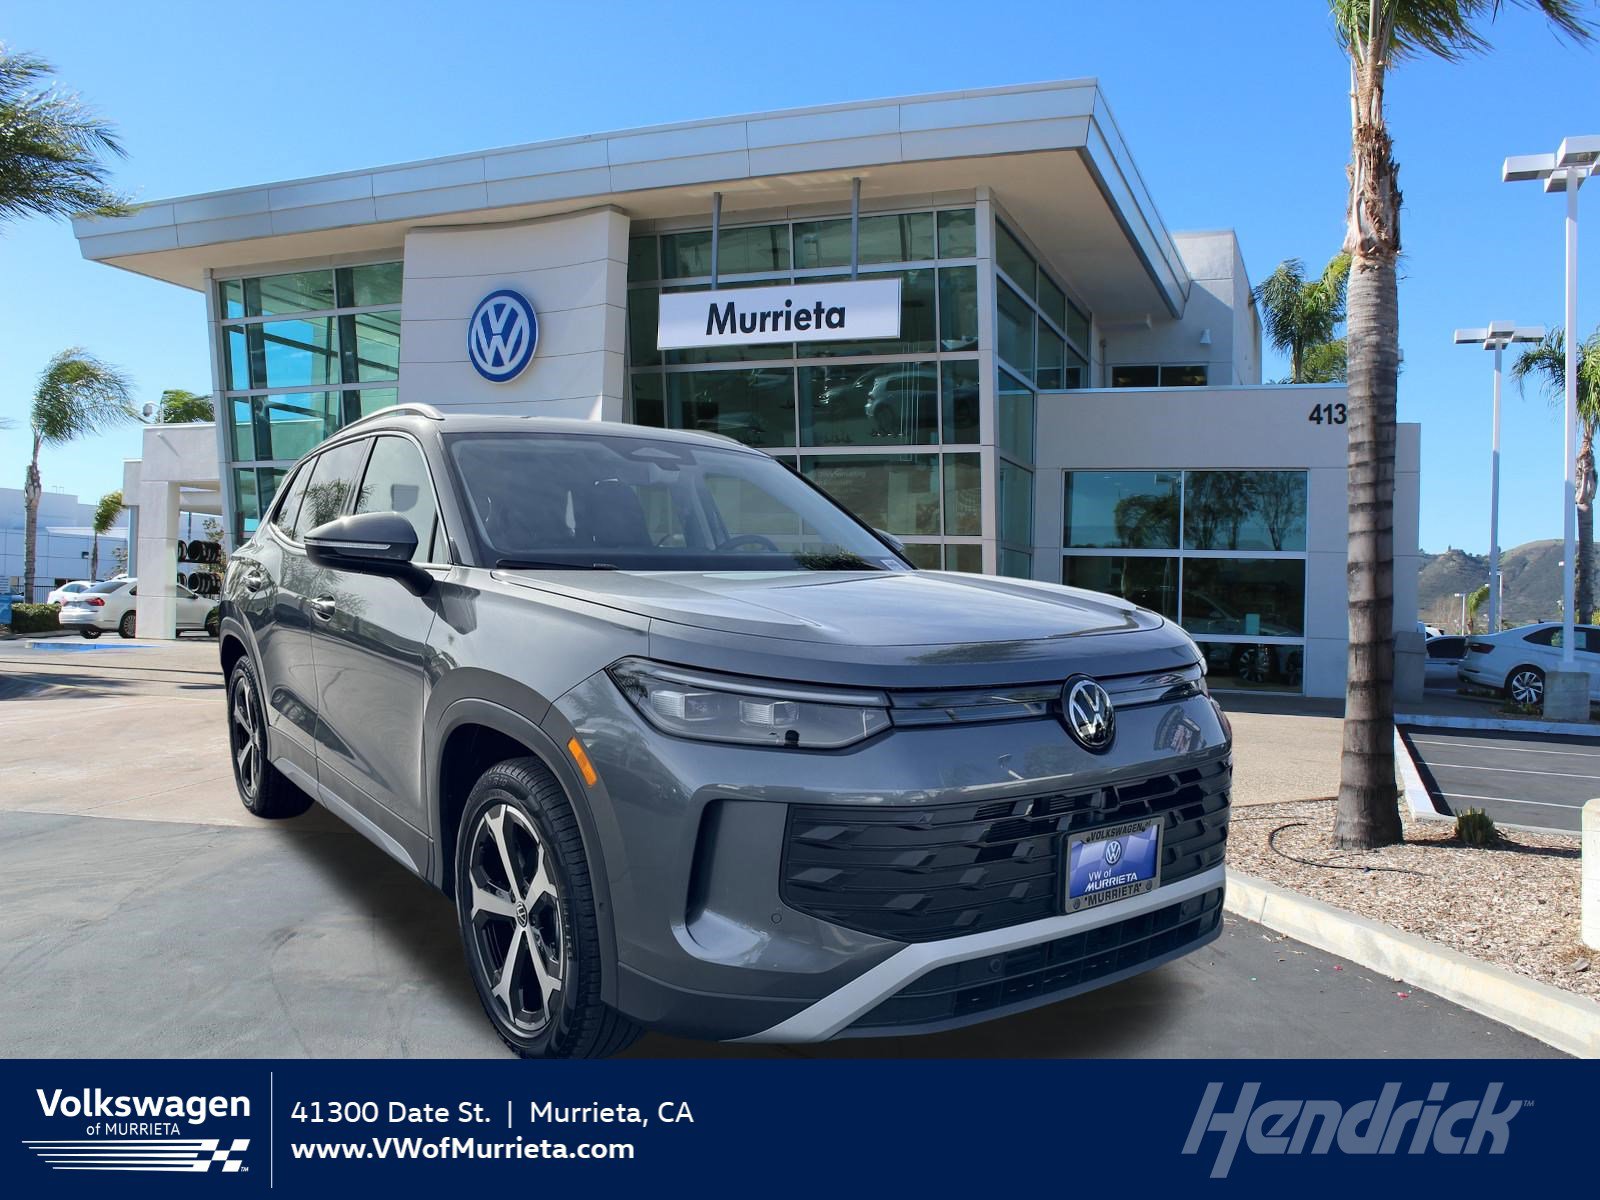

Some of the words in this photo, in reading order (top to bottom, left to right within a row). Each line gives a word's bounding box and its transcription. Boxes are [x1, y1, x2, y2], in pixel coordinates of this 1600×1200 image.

[705, 298, 846, 336] Murrieta
[1308, 403, 1347, 425] 413
[1090, 823, 1143, 841] VOLKSWAGEN
[1084, 872, 1138, 892] MURRIETA
[1088, 871, 1102, 882] VW
[1103, 868, 1112, 879] of
[1088, 885, 1140, 906] MURRIETA
